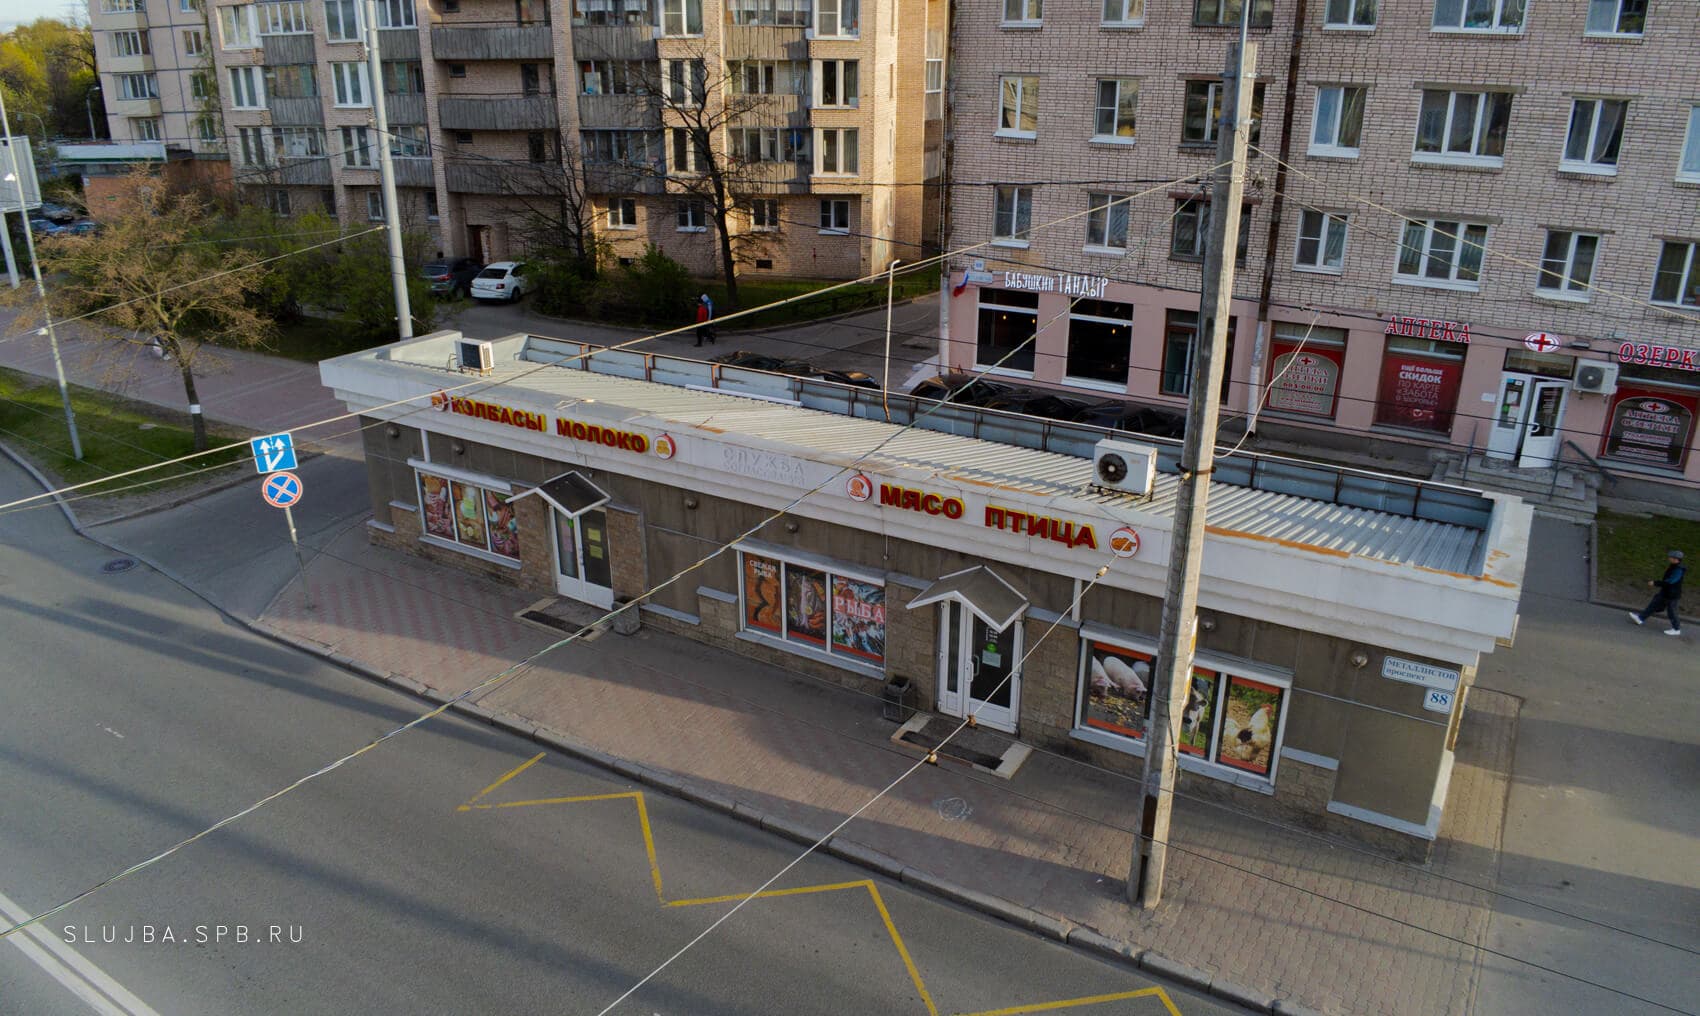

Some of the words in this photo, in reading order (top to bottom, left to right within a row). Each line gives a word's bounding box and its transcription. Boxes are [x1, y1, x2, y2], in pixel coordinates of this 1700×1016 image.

[1058, 273, 1109, 298] ТАНДЫР
[1385, 314, 1471, 343] АПТЕКА
[1618, 342, 1700, 371] ОЗЕРК
[1399, 371, 1442, 384] СКИДОК
[1413, 382, 1440, 393] КАРТЕ
[450, 396, 547, 432] КОЛБАСЫ
[556, 418, 650, 453] МОЛОКО
[880, 482, 965, 519] МЯСО
[984, 504, 1098, 550] ПТИЦА
[833, 596, 885, 625] РЫБА
[1387, 659, 1456, 680] МЕТАЛЛИСТОВ
[1430, 692, 1449, 706] 88
